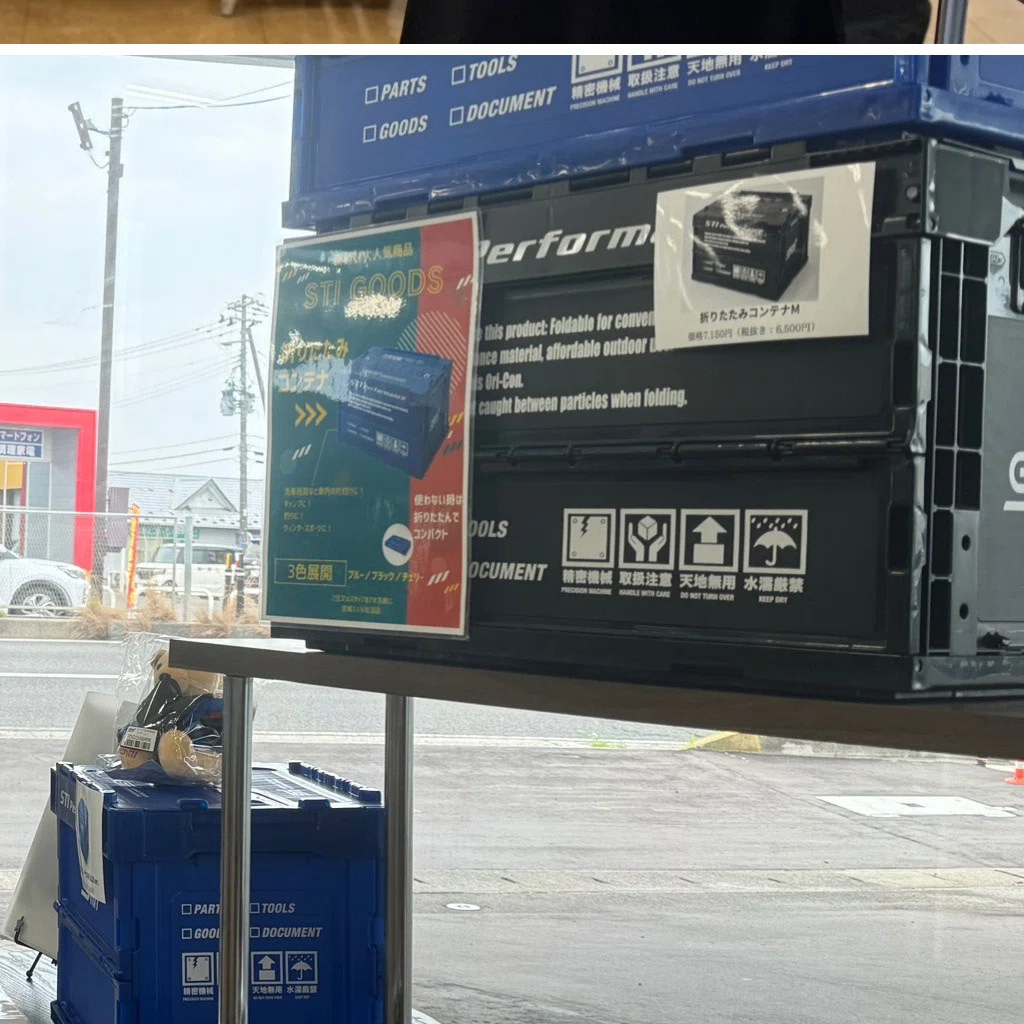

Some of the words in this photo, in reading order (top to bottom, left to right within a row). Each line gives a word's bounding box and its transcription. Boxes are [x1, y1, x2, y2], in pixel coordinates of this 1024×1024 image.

[469, 55, 518, 81] TOOLS
[687, 55, 742, 75] 天地無用
[628, 64, 679, 88] 取扱注意
[381, 75, 428, 102] PARTS
[571, 76, 622, 101] 精密機械
[466, 87, 557, 122] DOCUMENT
[379, 115, 429, 140] GOODS
[304, 280, 341, 311] STI
[349, 265, 444, 299] GOODS
[699, 304, 801, 324] 折りたたみコンテナM
[484, 324, 504, 341] this
[505, 319, 548, 341] product:
[550, 313, 595, 335] Foldable
[597, 313, 613, 330] for
[499, 343, 544, 364] material,
[546, 339, 601, 361] affordable
[603, 336, 648, 357] outdoor
[485, 371, 524, 391] Ori-Con.
[479, 397, 513, 417] caught
[514, 395, 558, 414] between
[560, 390, 608, 413] particles
[610, 390, 641, 409] when
[644, 387, 688, 408] folding.
[414, 494, 464, 507] 使わない時は
[414, 529, 449, 541] コンパクト
[469, 520, 509, 538] OOLS
[288, 564, 333, 582] 3色展開
[469, 561, 548, 582] OCUMENT
[562, 569, 613, 585] 精密機械
[619, 571, 673, 588] 取扱注意
[679, 573, 736, 591] 天地無用
[758, 595, 774, 603] KEEP
[194, 904, 221, 914] PART
[262, 903, 296, 914] TOOLS
[194, 928, 220, 939] GOO
[262, 927, 323, 938] DOCUMENT
